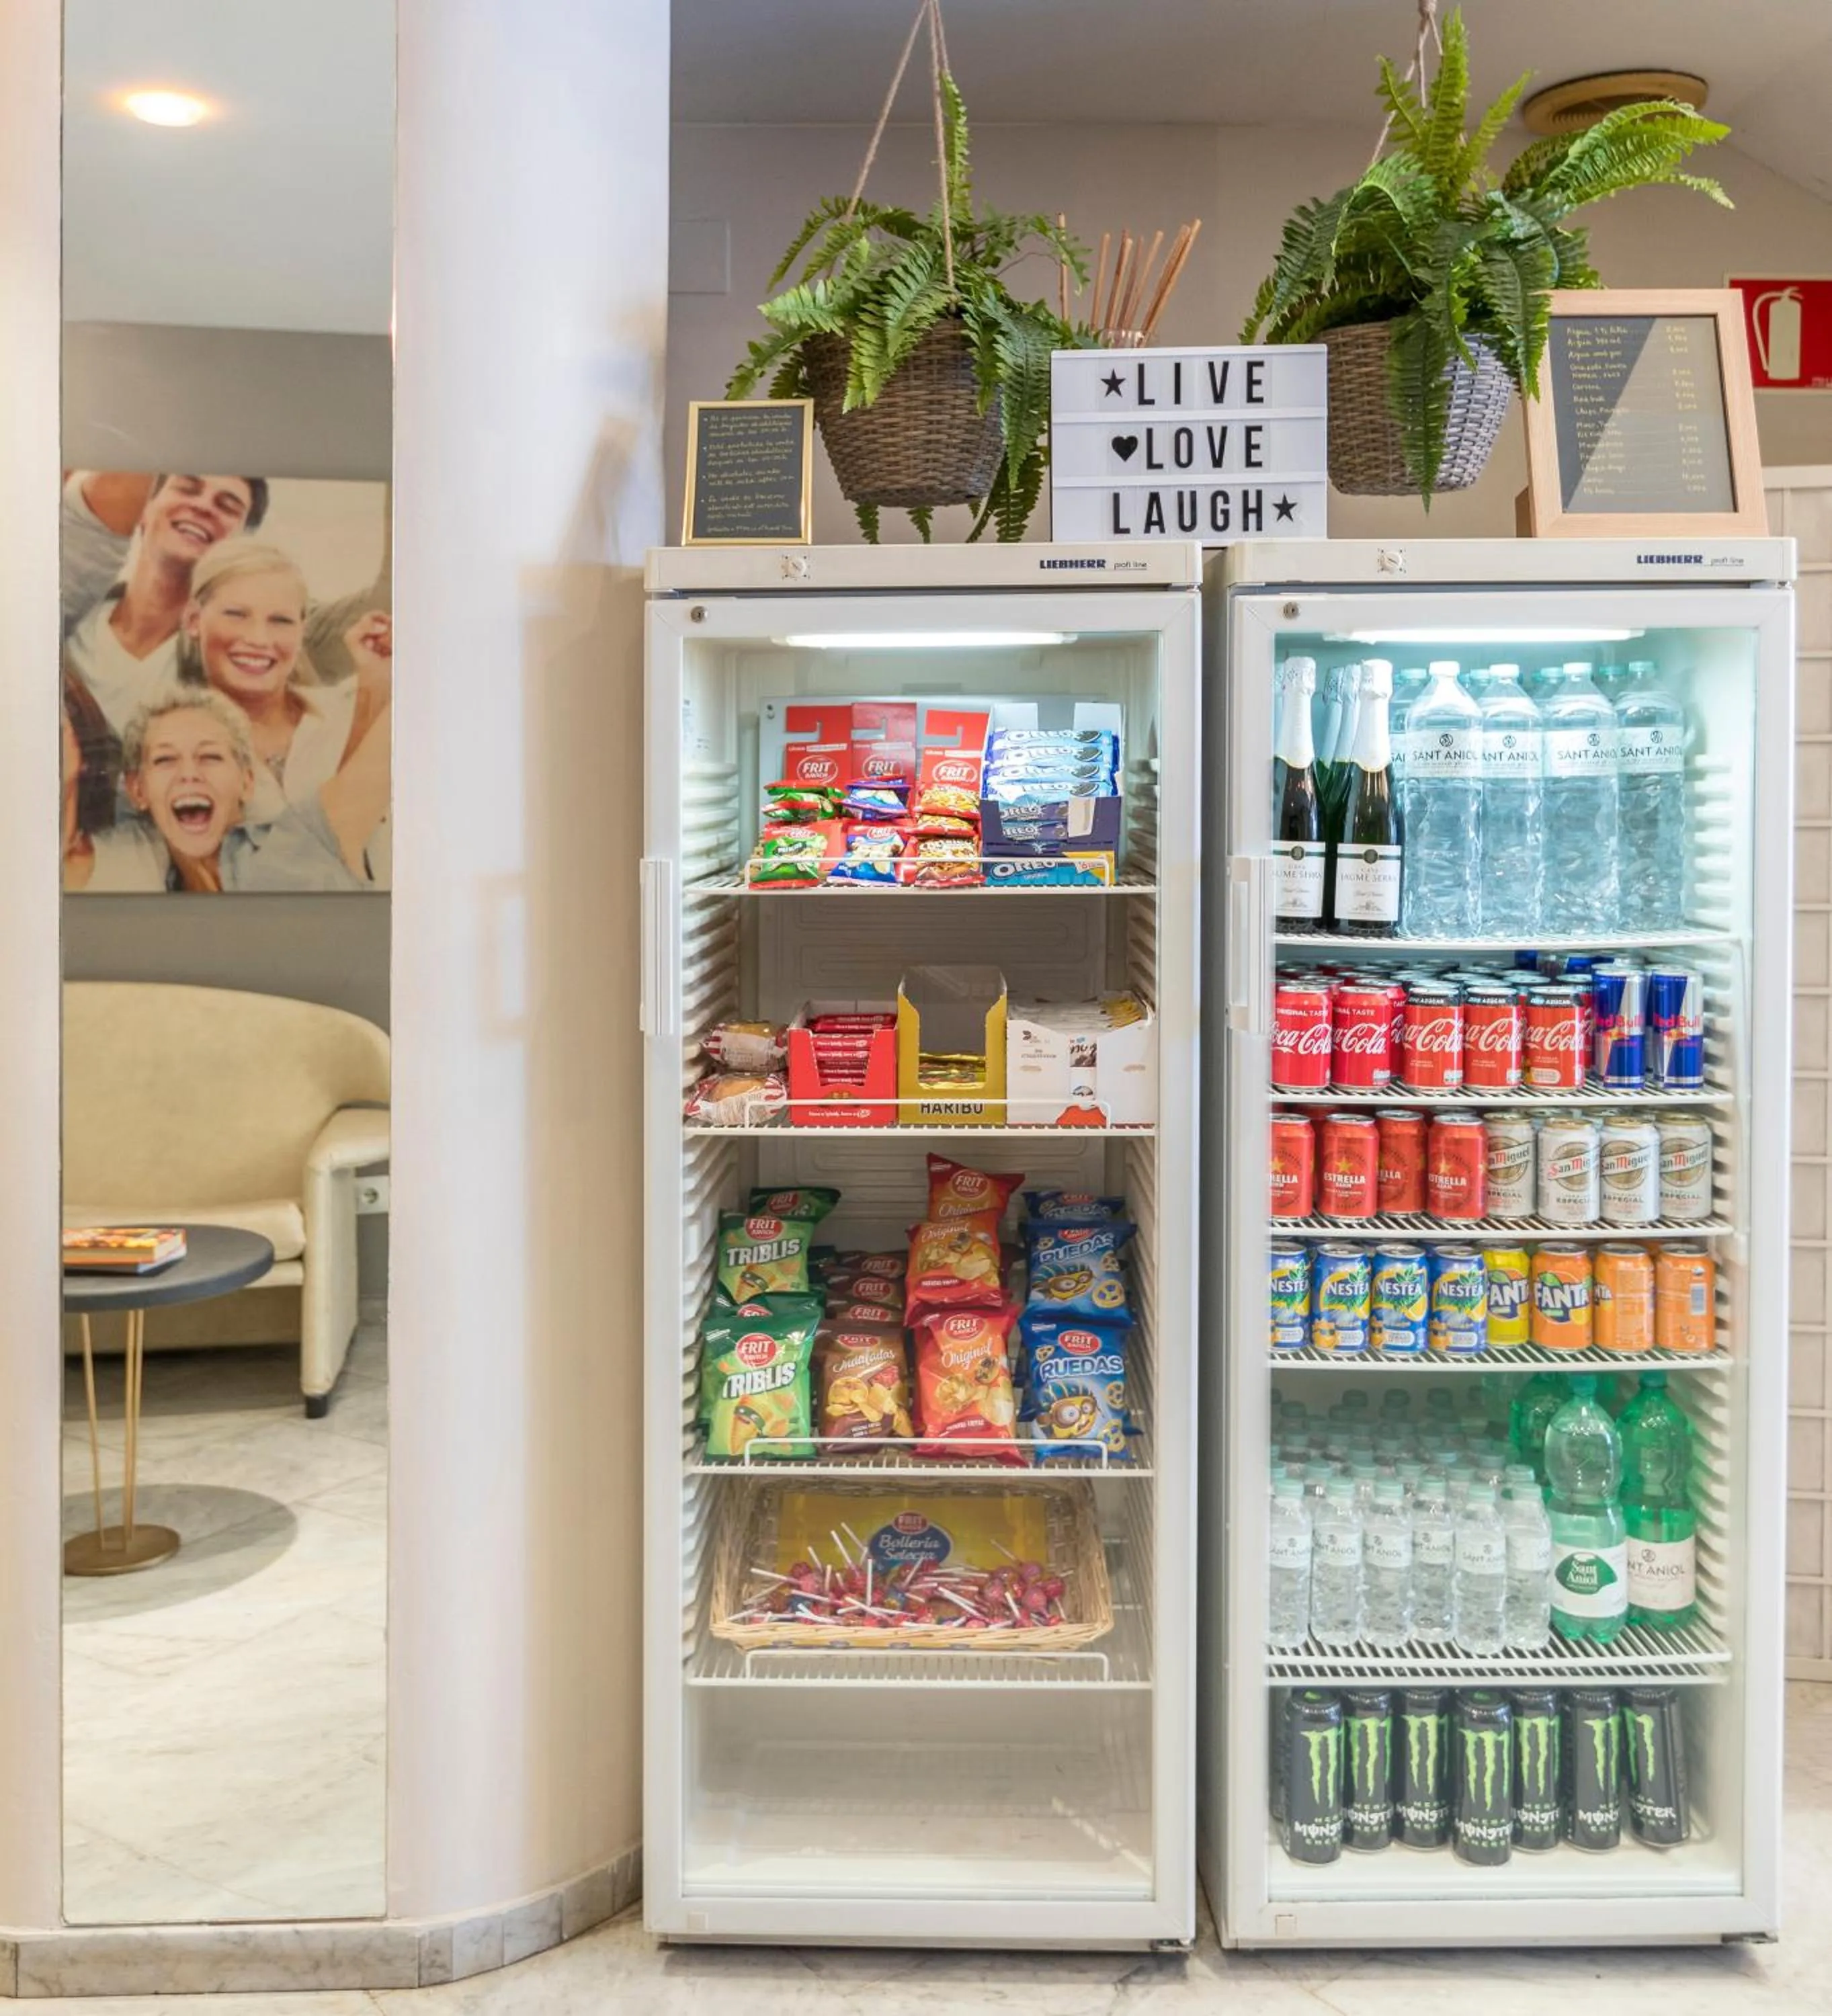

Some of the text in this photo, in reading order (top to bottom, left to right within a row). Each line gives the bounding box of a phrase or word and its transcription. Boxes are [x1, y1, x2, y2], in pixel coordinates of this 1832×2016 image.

[1137, 361, 1265, 405] LIVE
[1145, 425, 1263, 470] LOVE
[1112, 489, 1263, 534] LAUGH
[1040, 559, 1106, 569] LIEBHERR
[1636, 554, 1703, 564] LIEBHERR
[1413, 751, 1441, 761] SANT
[1557, 749, 1591, 760] SANT
[1620, 747, 1652, 757] SANT
[802, 761, 832, 773] FRIT
[868, 760, 897, 773] FRIT
[938, 765, 969, 778] FRIT
[993, 860, 1056, 878] OREO
[1352, 1008, 1376, 1016] TASTE
[955, 1176, 985, 1188] FRIT
[1324, 1172, 1366, 1184] ESTRELLA
[749, 1218, 778, 1230] FRIT
[726, 1238, 801, 1267] TRIBLIS
[1040, 1232, 1115, 1265] RUEDAS
[858, 1281, 886, 1293] FRIT
[1378, 1279, 1423, 1296] NESTEA
[1439, 1279, 1485, 1297] NESTEA
[1486, 1278, 1530, 1306] ANT
[1534, 1282, 1589, 1308] FANTA
[853, 1307, 882, 1316] FRIT
[950, 1318, 978, 1331] FRIT
[1064, 1334, 1094, 1344] FRIT
[741, 1341, 772, 1354] FRIT
[942, 1338, 993, 1370] Original
[1040, 1354, 1124, 1381] RUEDAS
[722, 1361, 797, 1399] TRIBLIS
[1572, 1560, 1597, 1573] Sant
[1646, 1564, 1685, 1577] ANIOL
[1567, 1570, 1598, 1585] Aniol
